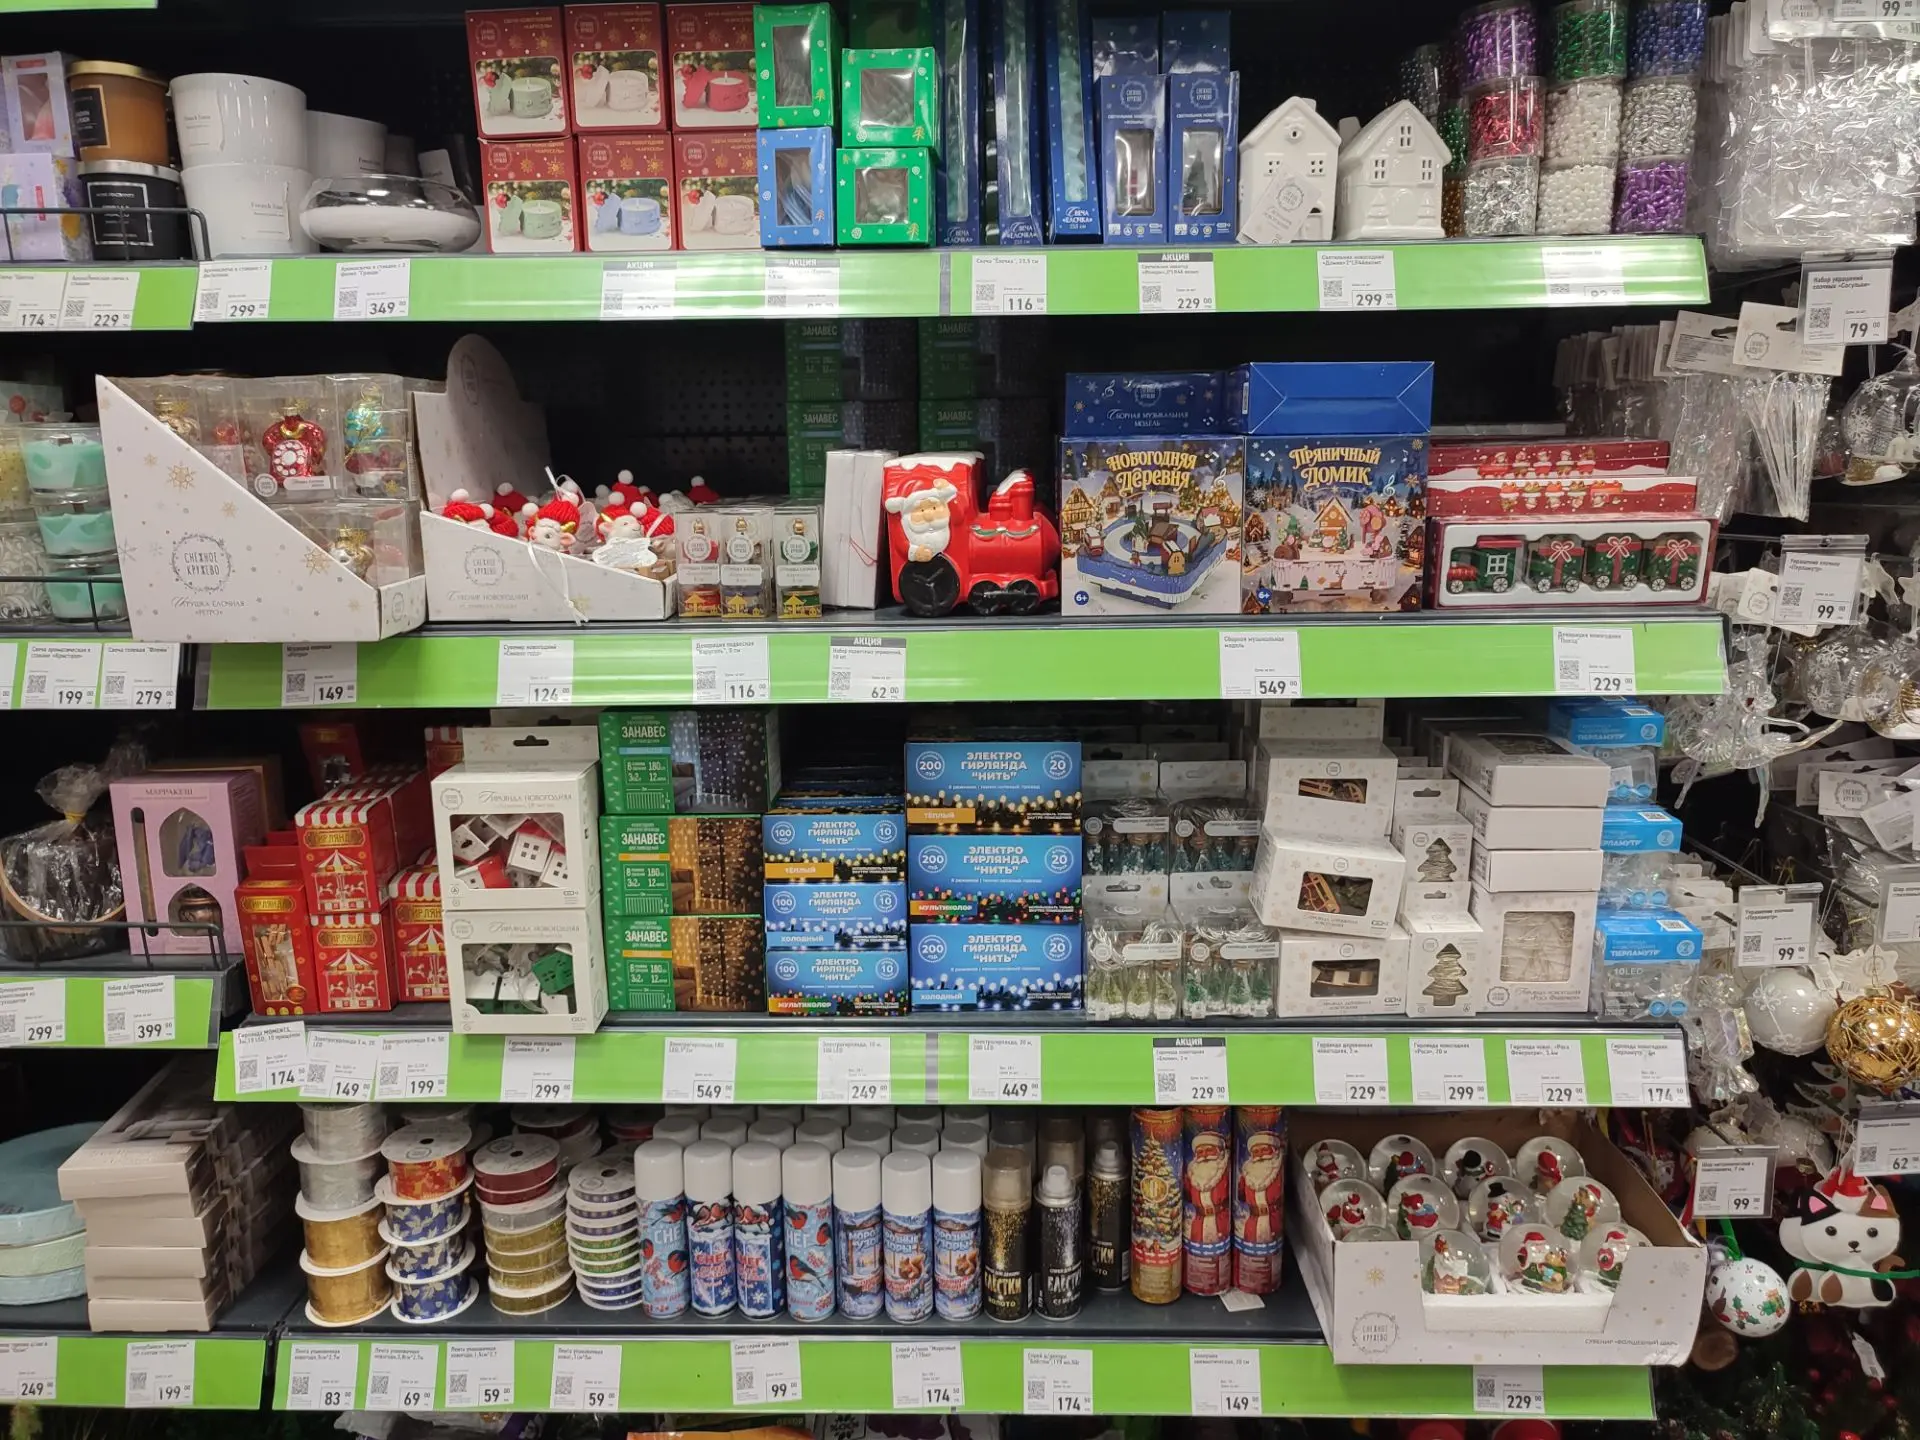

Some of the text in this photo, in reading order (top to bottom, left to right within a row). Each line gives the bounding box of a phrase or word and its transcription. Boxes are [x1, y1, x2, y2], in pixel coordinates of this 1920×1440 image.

[1881, 0, 1901, 17] 99
[788, 258, 818, 268] АКЦИЯ
[1161, 252, 1191, 261] АКЦИЯ
[625, 261, 654, 270] АКЦИЯ
[1008, 297, 1033, 311] 116
[1177, 297, 1200, 309] 229
[1355, 293, 1382, 306] 299
[229, 304, 256, 318] 299
[368, 302, 396, 316] 349
[21, 313, 45, 327] 174
[93, 314, 120, 328] 229
[801, 325, 839, 336] ЗАНАВЕС
[1850, 322, 1869, 339] 79
[801, 412, 839, 424] ЗАНАВЕС
[1106, 449, 1198, 470] НОВОГОДНЯЯ
[1288, 446, 1382, 470] ПРЯНИЧНЫЙ
[1300, 466, 1373, 491] ДОМИК
[184, 551, 218, 564] СНЕЖНОЕ
[186, 564, 220, 576] КРУЖЕВО
[1076, 593, 1089, 603] 6+
[1258, 591, 1271, 600] 6+
[1817, 604, 1835, 620] 99
[853, 637, 883, 647] АКЦИЯ
[1258, 680, 1286, 694] 549
[1592, 677, 1621, 691] 229
[58, 690, 83, 705] 199
[135, 690, 162, 705] 279
[318, 686, 344, 702] 149
[533, 687, 559, 702] 124
[729, 684, 755, 699] 116
[871, 686, 887, 699] 62
[621, 725, 666, 739] ЗАНАВЕС
[966, 751, 1023, 761] ЭЛЕКТРО
[919, 761, 942, 771] 200
[960, 760, 1028, 771] ГИРЛЯНДА
[1049, 760, 1067, 771] 20
[923, 810, 956, 820] ТЁПЛЫЙ
[811, 821, 857, 830] ЭЛЕКТРО
[879, 827, 892, 837] 10
[620, 832, 667, 846] ЗАНАВЕС
[774, 829, 792, 838] 100
[807, 829, 862, 837] ГИРЛЯНДА
[968, 845, 1024, 855] ЭЛЕКТРО
[1603, 839, 1642, 847] РЛАМУТР
[922, 854, 945, 865] 200
[963, 854, 1030, 865] ГИРЛЯНДА
[1050, 854, 1068, 865] 20
[783, 865, 817, 875] ТЁПЛЫЙ
[812, 891, 857, 899] ЭЛЕКТРО
[879, 897, 893, 906] 10
[775, 899, 793, 908] 100
[808, 898, 862, 907] ГИРЛЯНДА
[918, 903, 973, 912] МУЛЬТИКОЛОР
[624, 929, 669, 943] ЗАНАВЕС
[781, 935, 825, 944] ХОЛОДНЫЙ
[967, 935, 1023, 944] ЭЛЕКТРО
[922, 943, 945, 954] 200
[962, 943, 1028, 954] ГИРЛЯНДА
[1049, 942, 1067, 953] 20
[1610, 949, 1661, 958] ПЕРЛАМУТР
[1777, 947, 1795, 961] 99
[778, 965, 796, 974] 100
[811, 965, 864, 974] ГИРЛЯНДА
[815, 958, 860, 967] ЭЛЕКТРО
[881, 964, 894, 973] 10
[920, 992, 963, 1001] ХОЛОДНЫЙ
[777, 1000, 833, 1010] МУЛЬТИКОЛОР
[27, 1026, 53, 1041] 299
[137, 1023, 163, 1039] 399
[1175, 1037, 1203, 1047] АКЦИЯ
[270, 1069, 295, 1086] 174
[335, 1081, 361, 1097] 149
[410, 1079, 435, 1095] 199
[535, 1083, 561, 1099] 299
[696, 1084, 722, 1099] 549
[851, 1084, 878, 1100] 249
[1001, 1082, 1029, 1098] 449
[1191, 1086, 1214, 1100] 229
[1349, 1085, 1376, 1101] 229
[1448, 1086, 1475, 1101] 299
[1545, 1087, 1573, 1102] 229
[1647, 1087, 1674, 1102] 174
[1892, 1157, 1909, 1171] 62
[1732, 1197, 1750, 1211] 99
[653, 1227, 681, 1244] СНЕ
[20, 1382, 44, 1396] 249
[159, 1385, 181, 1401] 199
[483, 1388, 500, 1403] 59
[771, 1383, 787, 1398] 99
[926, 1388, 950, 1403] 174
[324, 1391, 341, 1406] 83
[403, 1391, 420, 1406] 69
[588, 1392, 605, 1407] 59
[1057, 1396, 1081, 1412] 174
[1225, 1396, 1250, 1411] 149
[1506, 1394, 1532, 1410] 229
